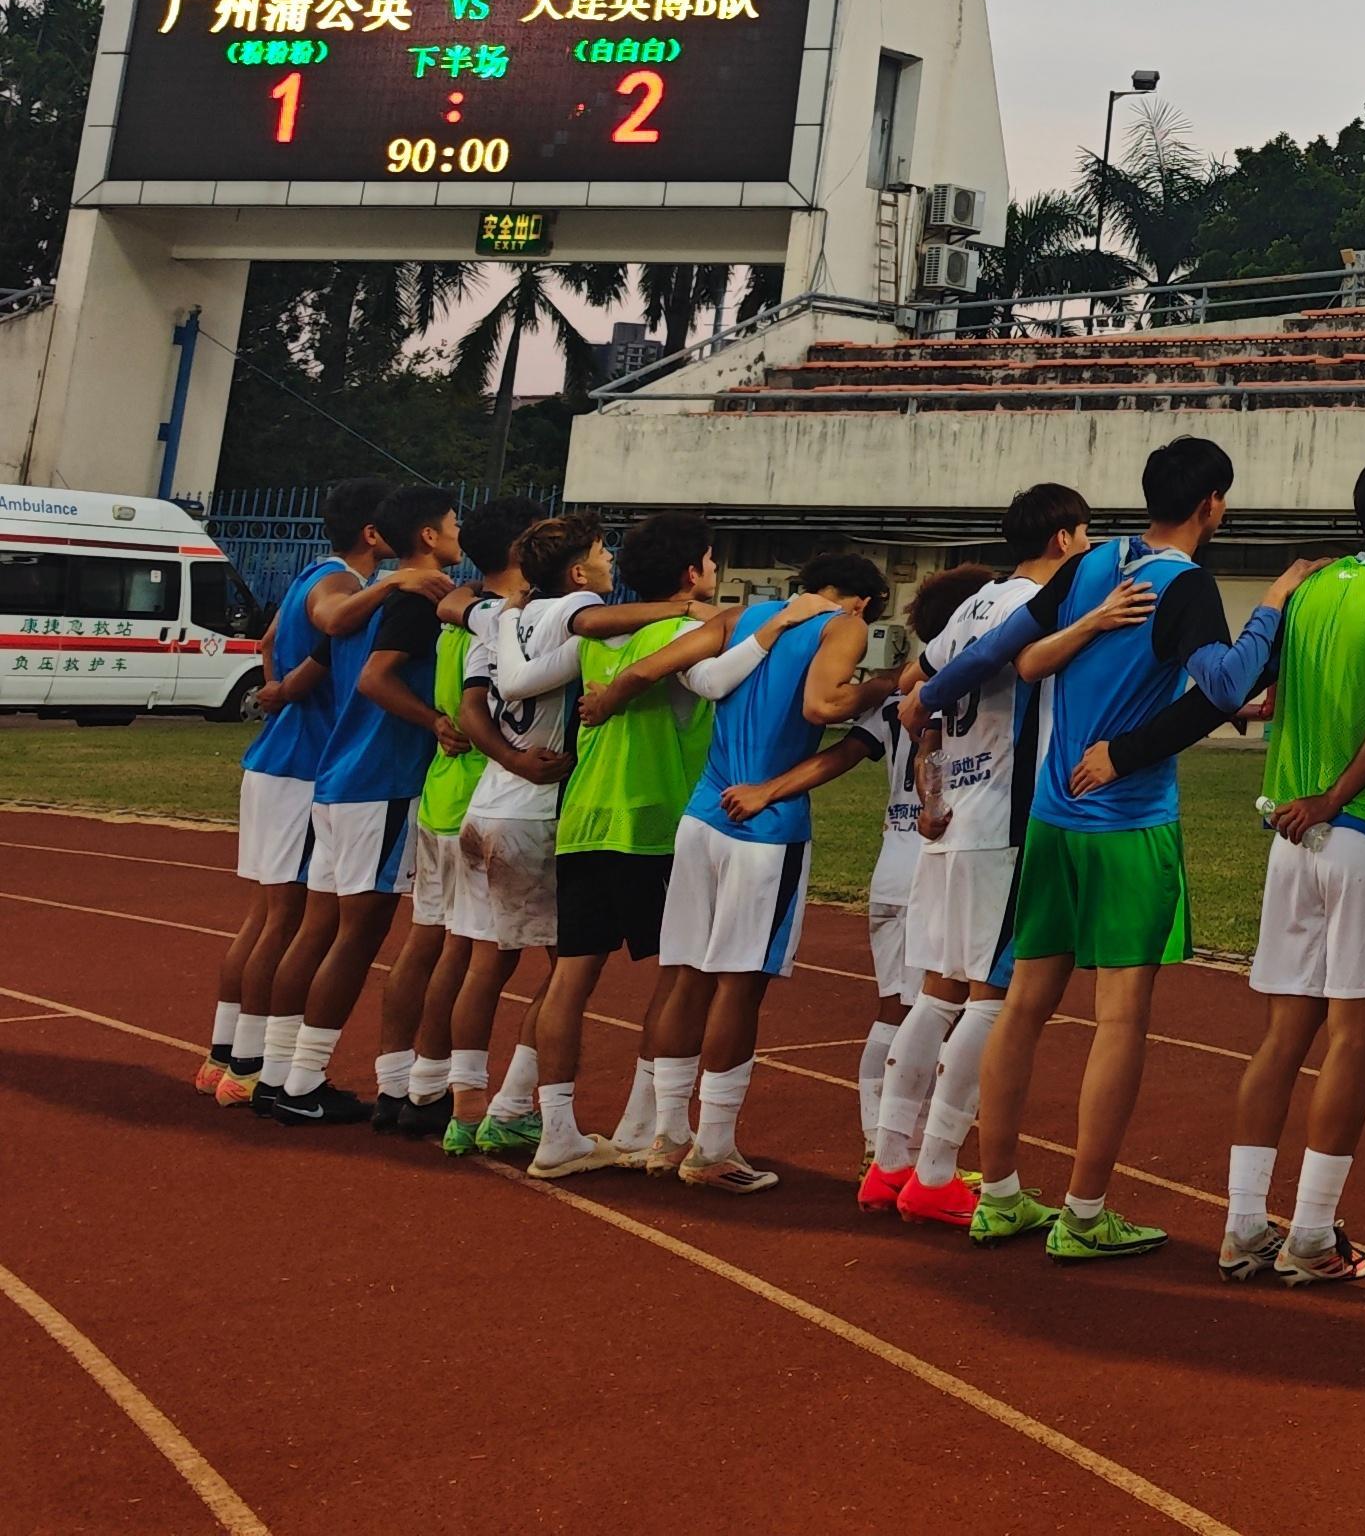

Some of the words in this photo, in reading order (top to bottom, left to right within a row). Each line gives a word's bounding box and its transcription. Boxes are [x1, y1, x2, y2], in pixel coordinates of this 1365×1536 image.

[408, 44, 510, 79] 下半场
[270, 71, 303, 144] 1
[611, 71, 665, 144] 2
[387, 138, 510, 174] 90:00
[482, 214, 544, 241] 安全出口
[494, 241, 526, 251] EXIT
[0, 495, 78, 517] Ambulance
[19, 618, 134, 637] 康捷急救站
[11, 656, 129, 672] 负压救护车
